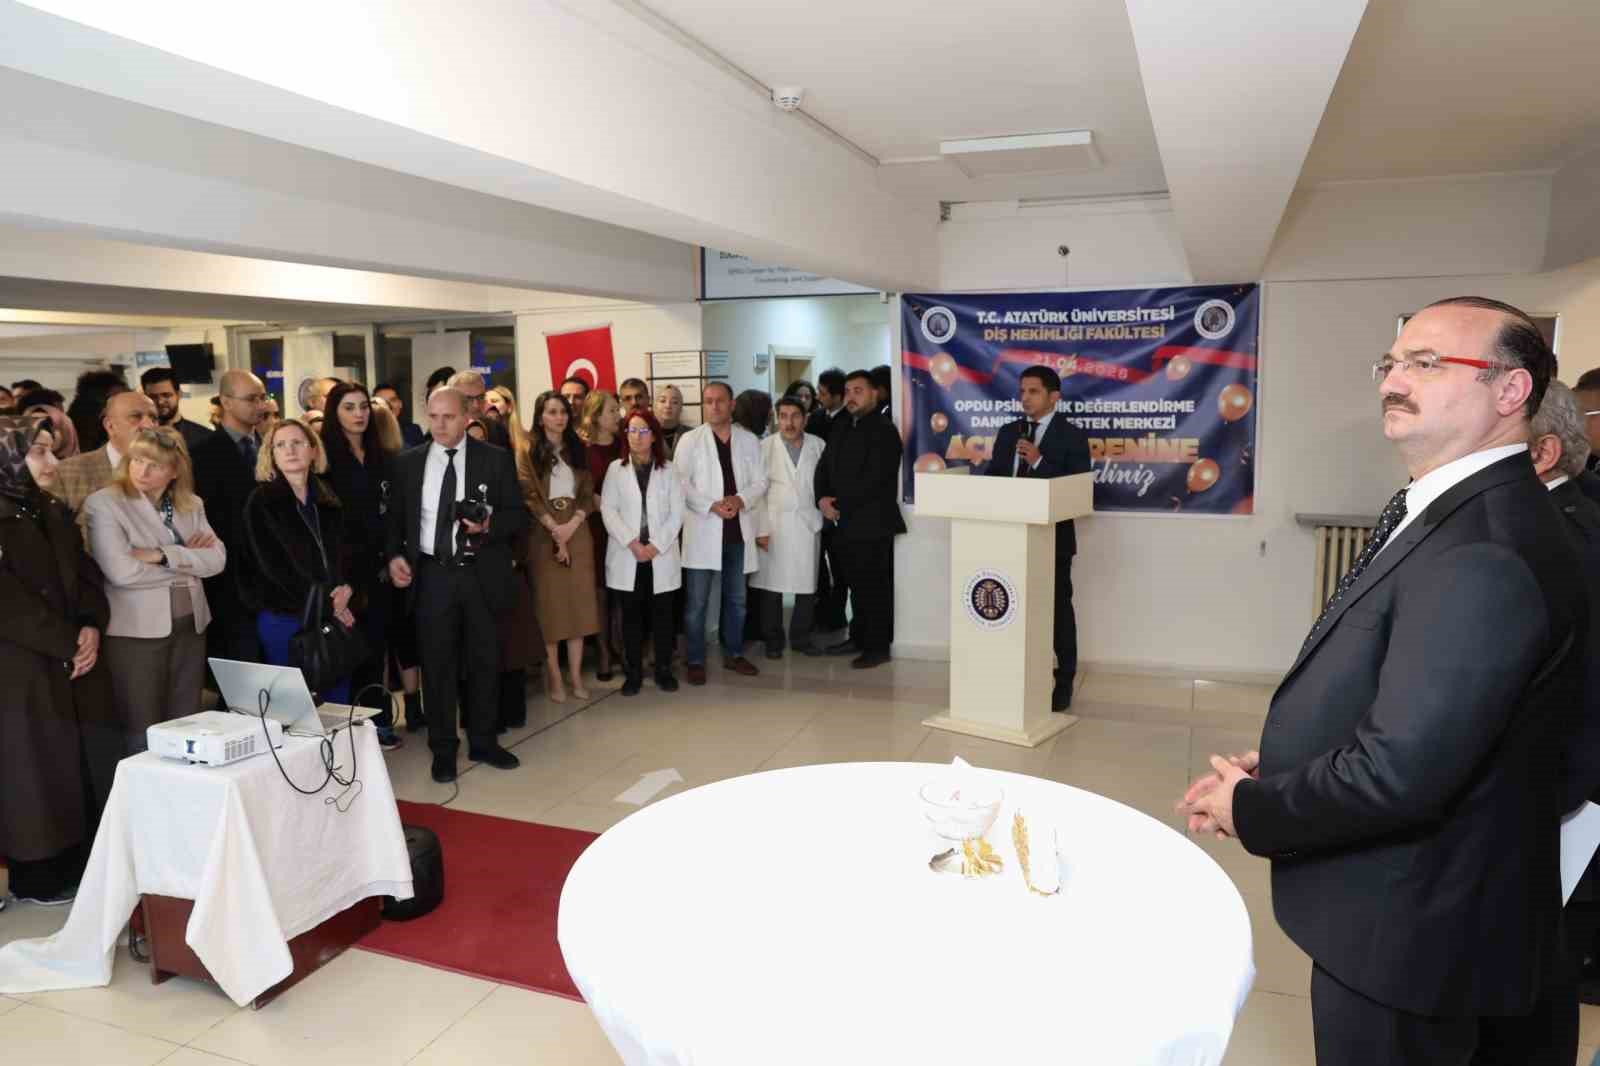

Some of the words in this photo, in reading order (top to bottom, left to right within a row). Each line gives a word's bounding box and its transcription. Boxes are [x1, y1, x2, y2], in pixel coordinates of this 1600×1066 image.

[976, 310, 1001, 324] T.C.
[1004, 308, 1069, 324] ATATÜRK
[1070, 304, 1175, 323] ÜNİVERSİTESİ
[984, 327, 1008, 342] DİŞ
[1010, 325, 1084, 341] HEKİMLİĞİ
[1086, 322, 1166, 340] FAKÜLTESİ
[954, 400, 994, 413] OPDU
[1074, 398, 1195, 413] DEĞERLENDİRME
[1113, 414, 1176, 430] MERKEZİ
